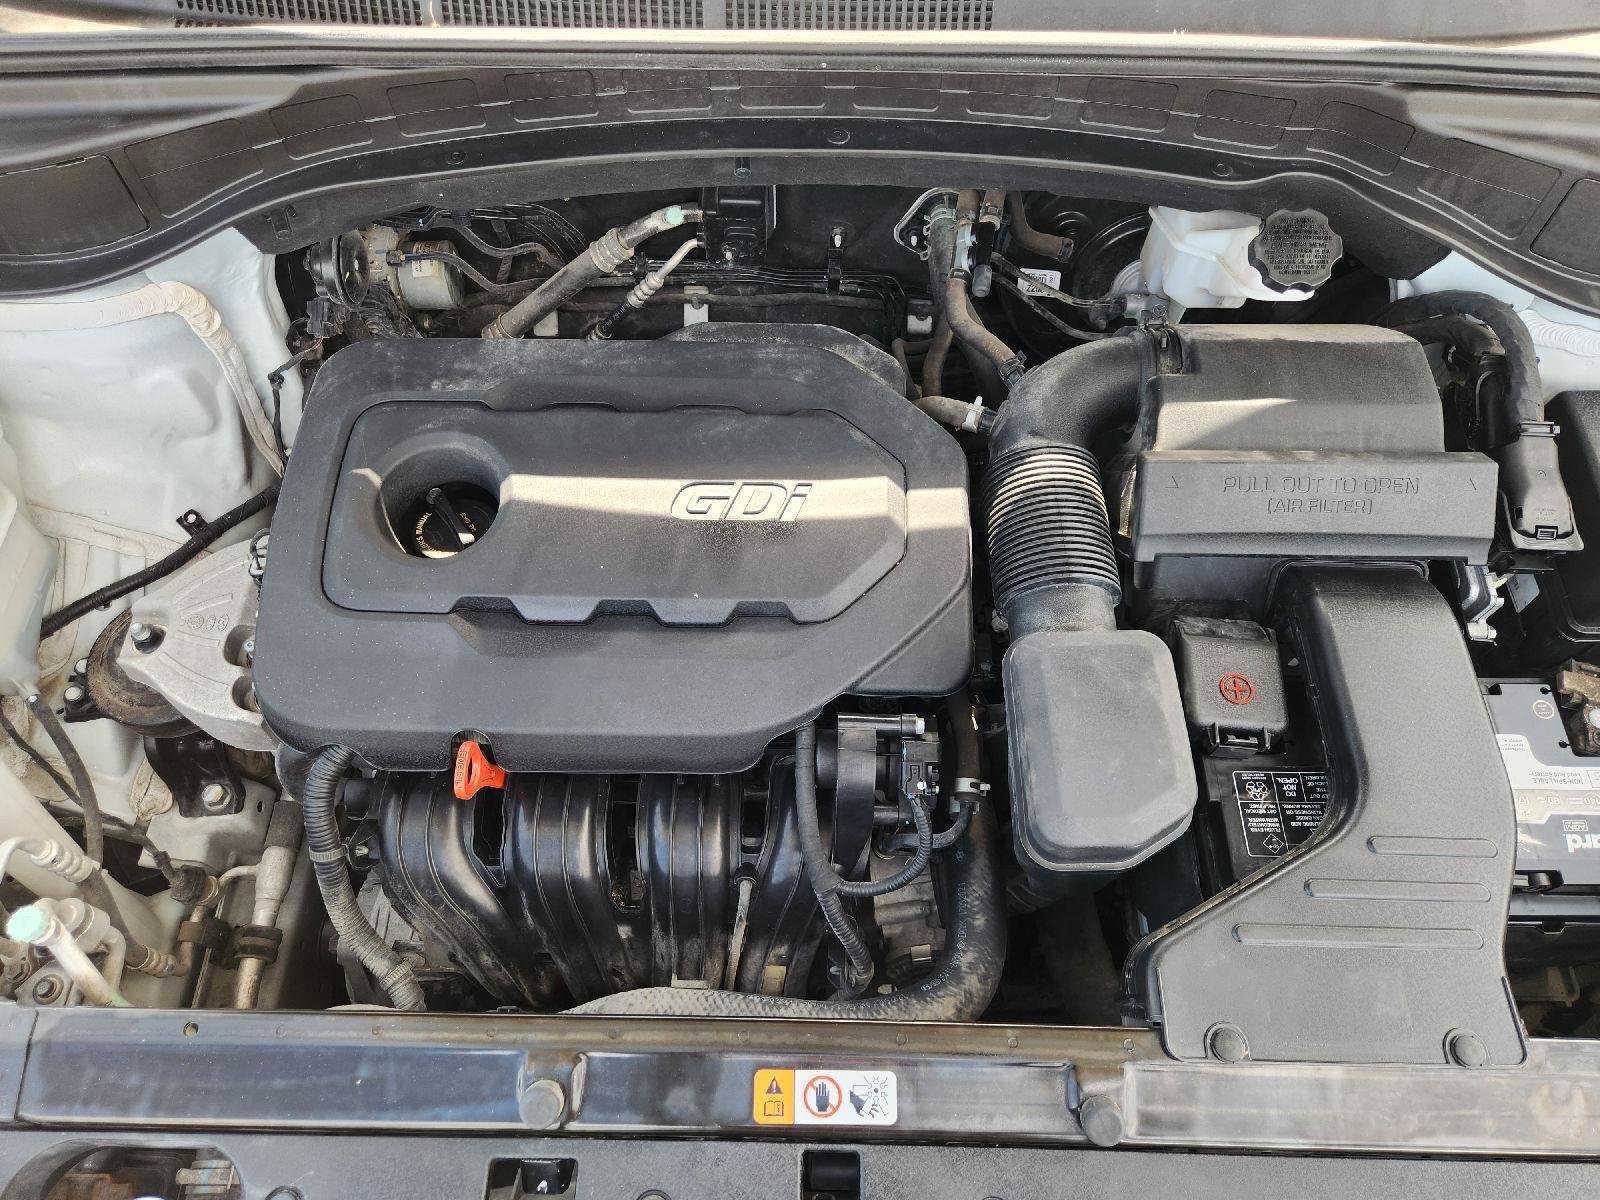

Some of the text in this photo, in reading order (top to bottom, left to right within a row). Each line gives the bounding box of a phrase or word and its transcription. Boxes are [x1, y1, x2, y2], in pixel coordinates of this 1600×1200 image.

[1223, 476, 1419, 495] PULL OUT TO OPEN
[670, 481, 813, 521] GDi
[415, 512, 432, 535] MANUAL
